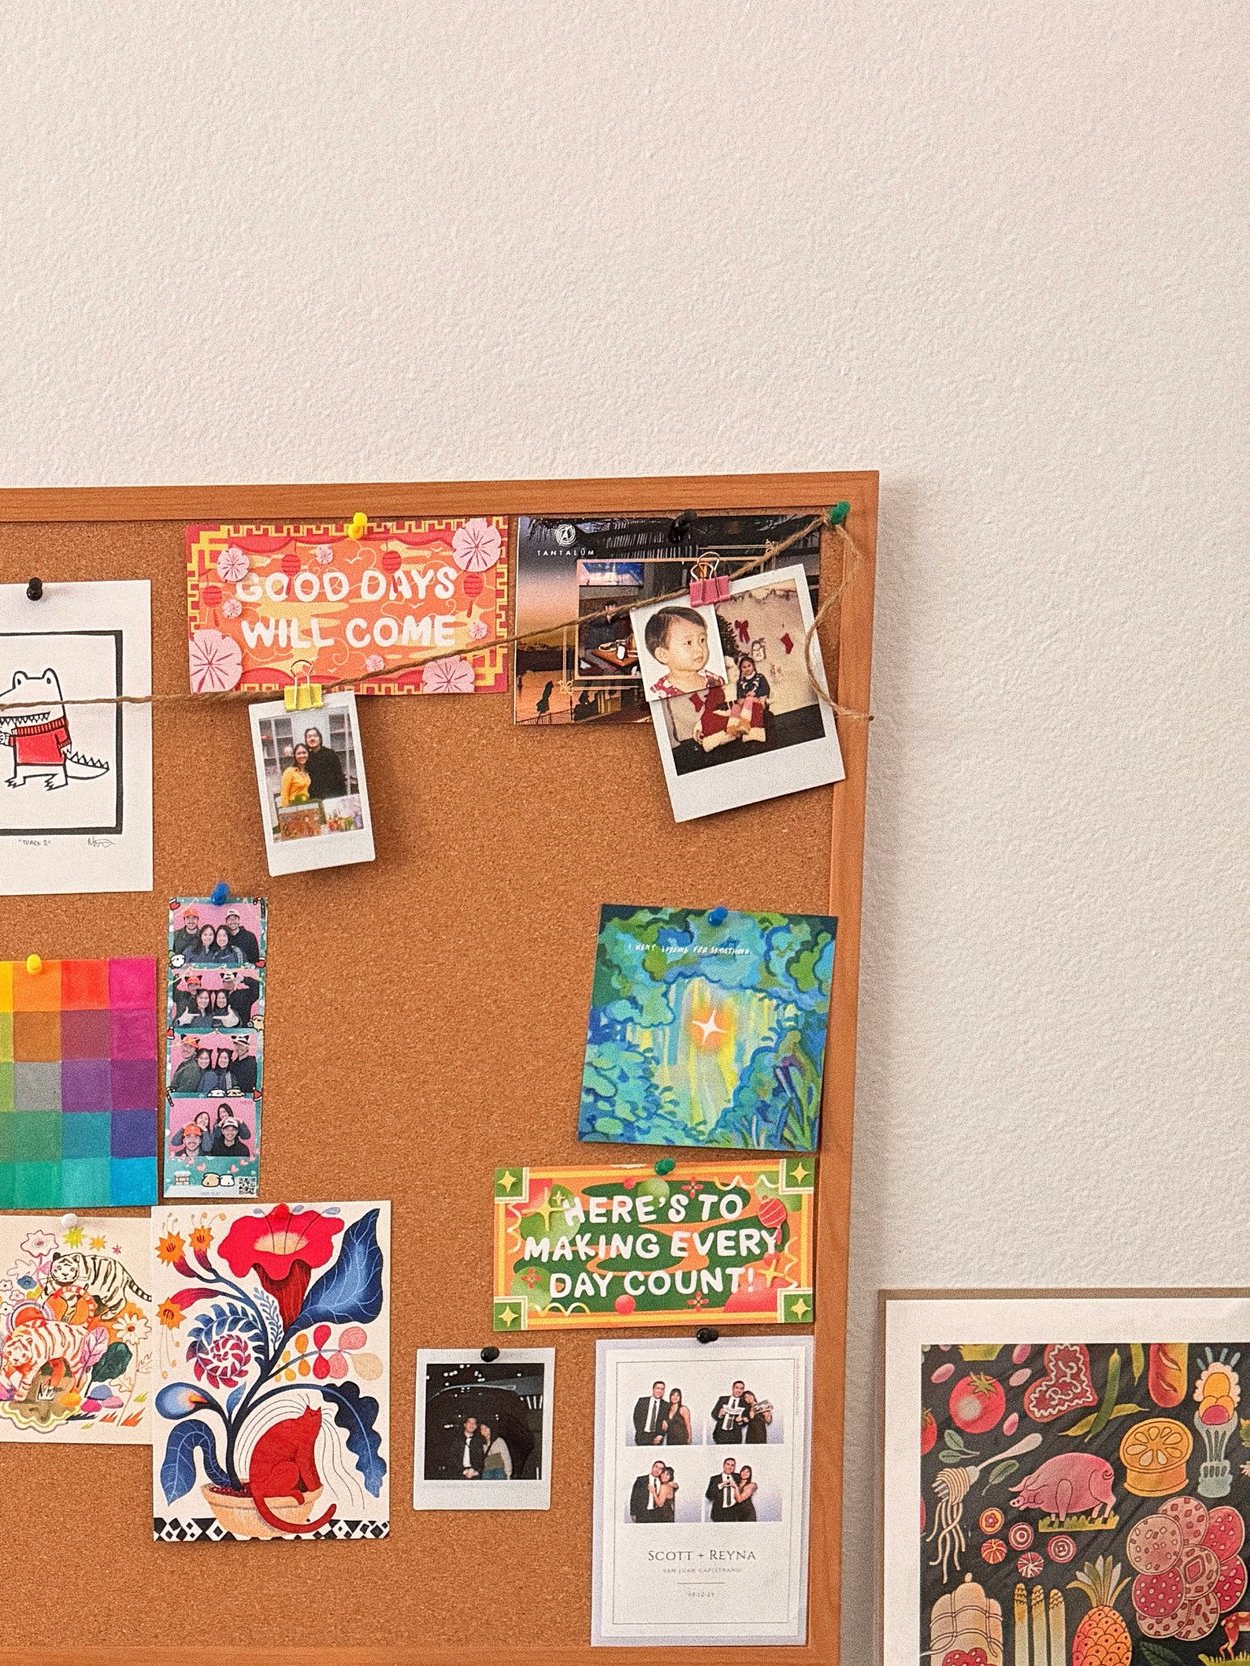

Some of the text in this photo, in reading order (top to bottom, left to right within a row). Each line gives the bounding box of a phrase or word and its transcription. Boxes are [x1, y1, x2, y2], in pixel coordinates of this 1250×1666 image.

[235, 566, 458, 602] GOOD DAYS
[241, 615, 456, 649] WILL COME
[562, 1194, 743, 1227] HERE'S TO
[523, 1228, 778, 1262] MAKING EVERY
[549, 1267, 755, 1298] DAY COUNT!
[648, 1550, 693, 1561] SCOTT
[709, 1549, 756, 1561] REYNA
